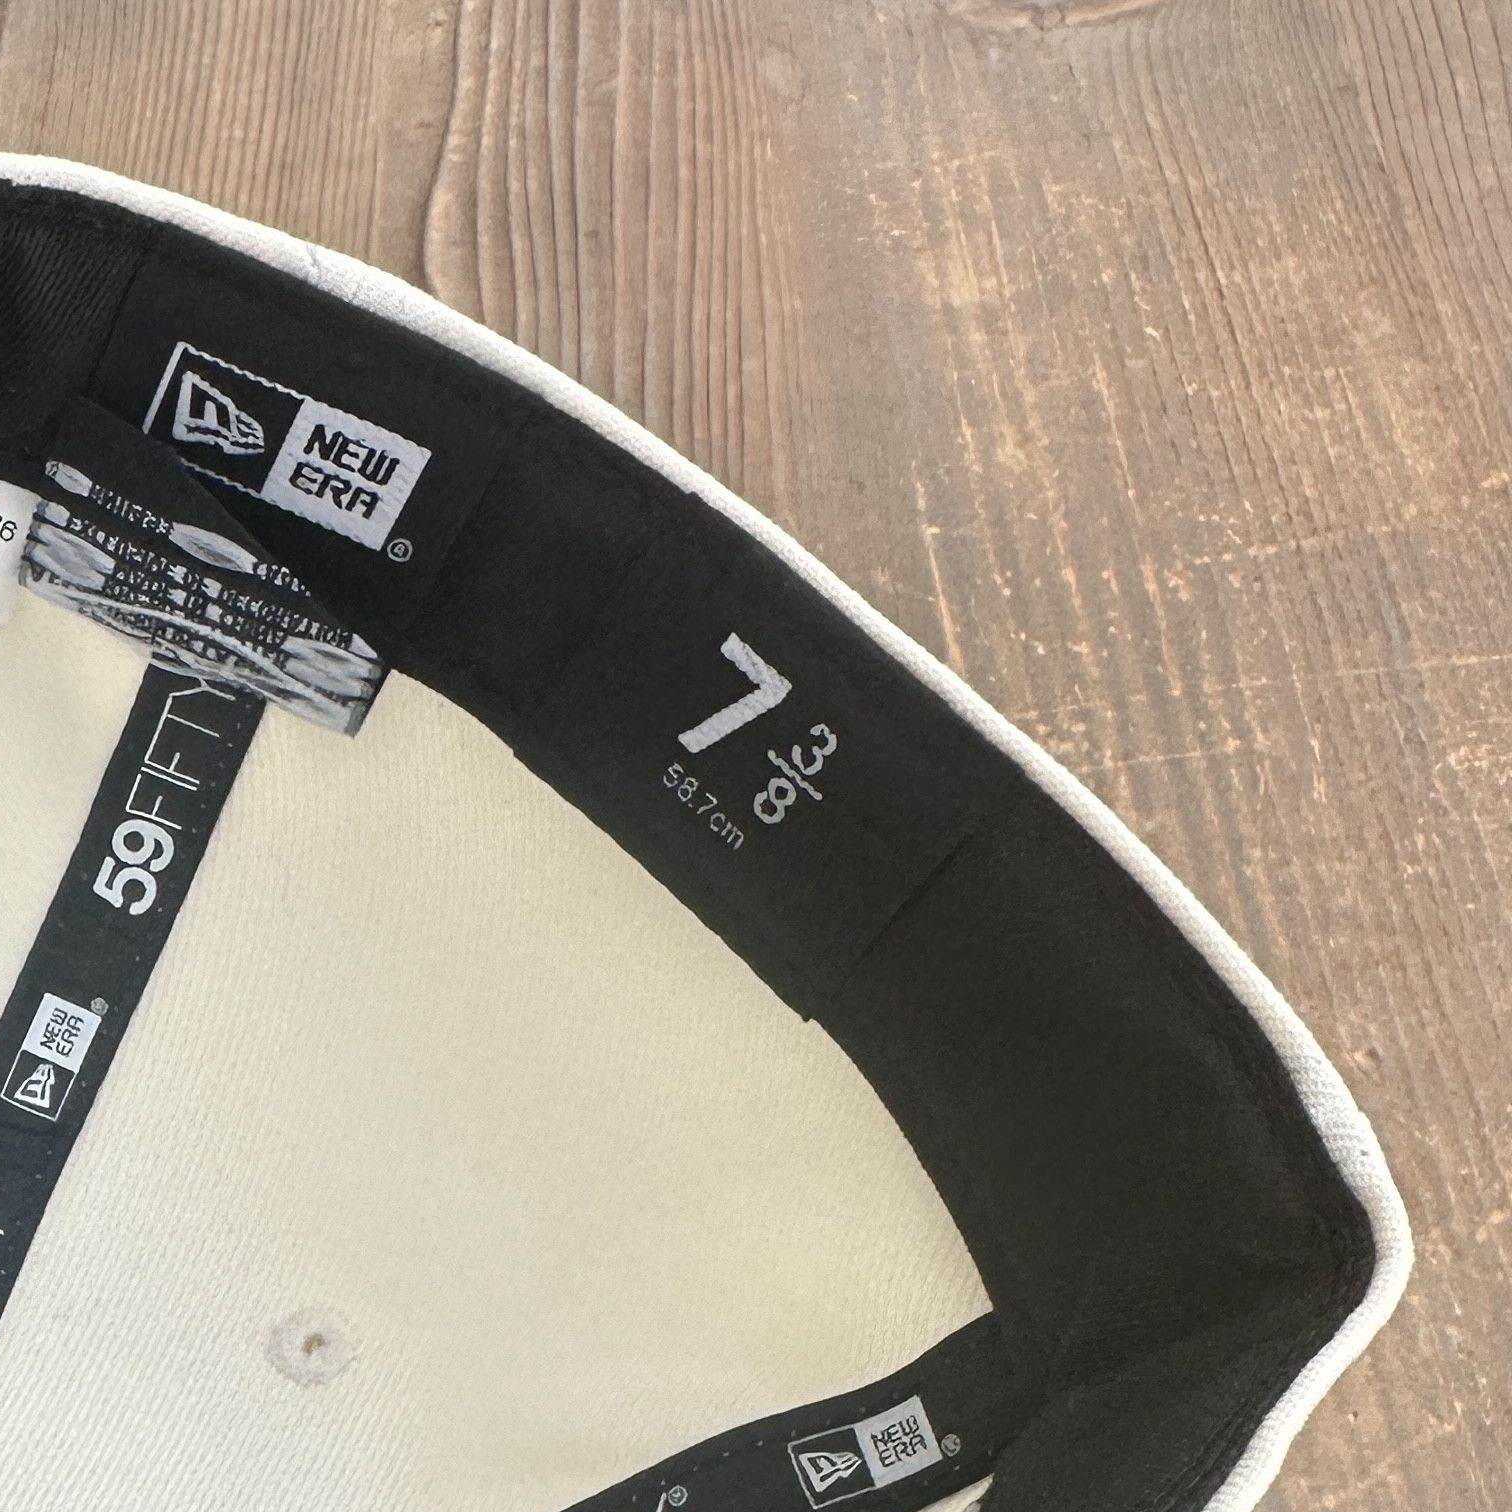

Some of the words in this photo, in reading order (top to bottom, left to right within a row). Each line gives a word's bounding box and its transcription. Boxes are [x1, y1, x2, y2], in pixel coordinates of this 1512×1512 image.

[303, 423, 401, 487] NEW
[288, 461, 382, 520] ERA
[677, 631, 793, 754] 7
[92, 678, 236, 916] 59FIFTY
[870, 1414, 921, 1452] NEW
[878, 1432, 928, 1468] ERA
